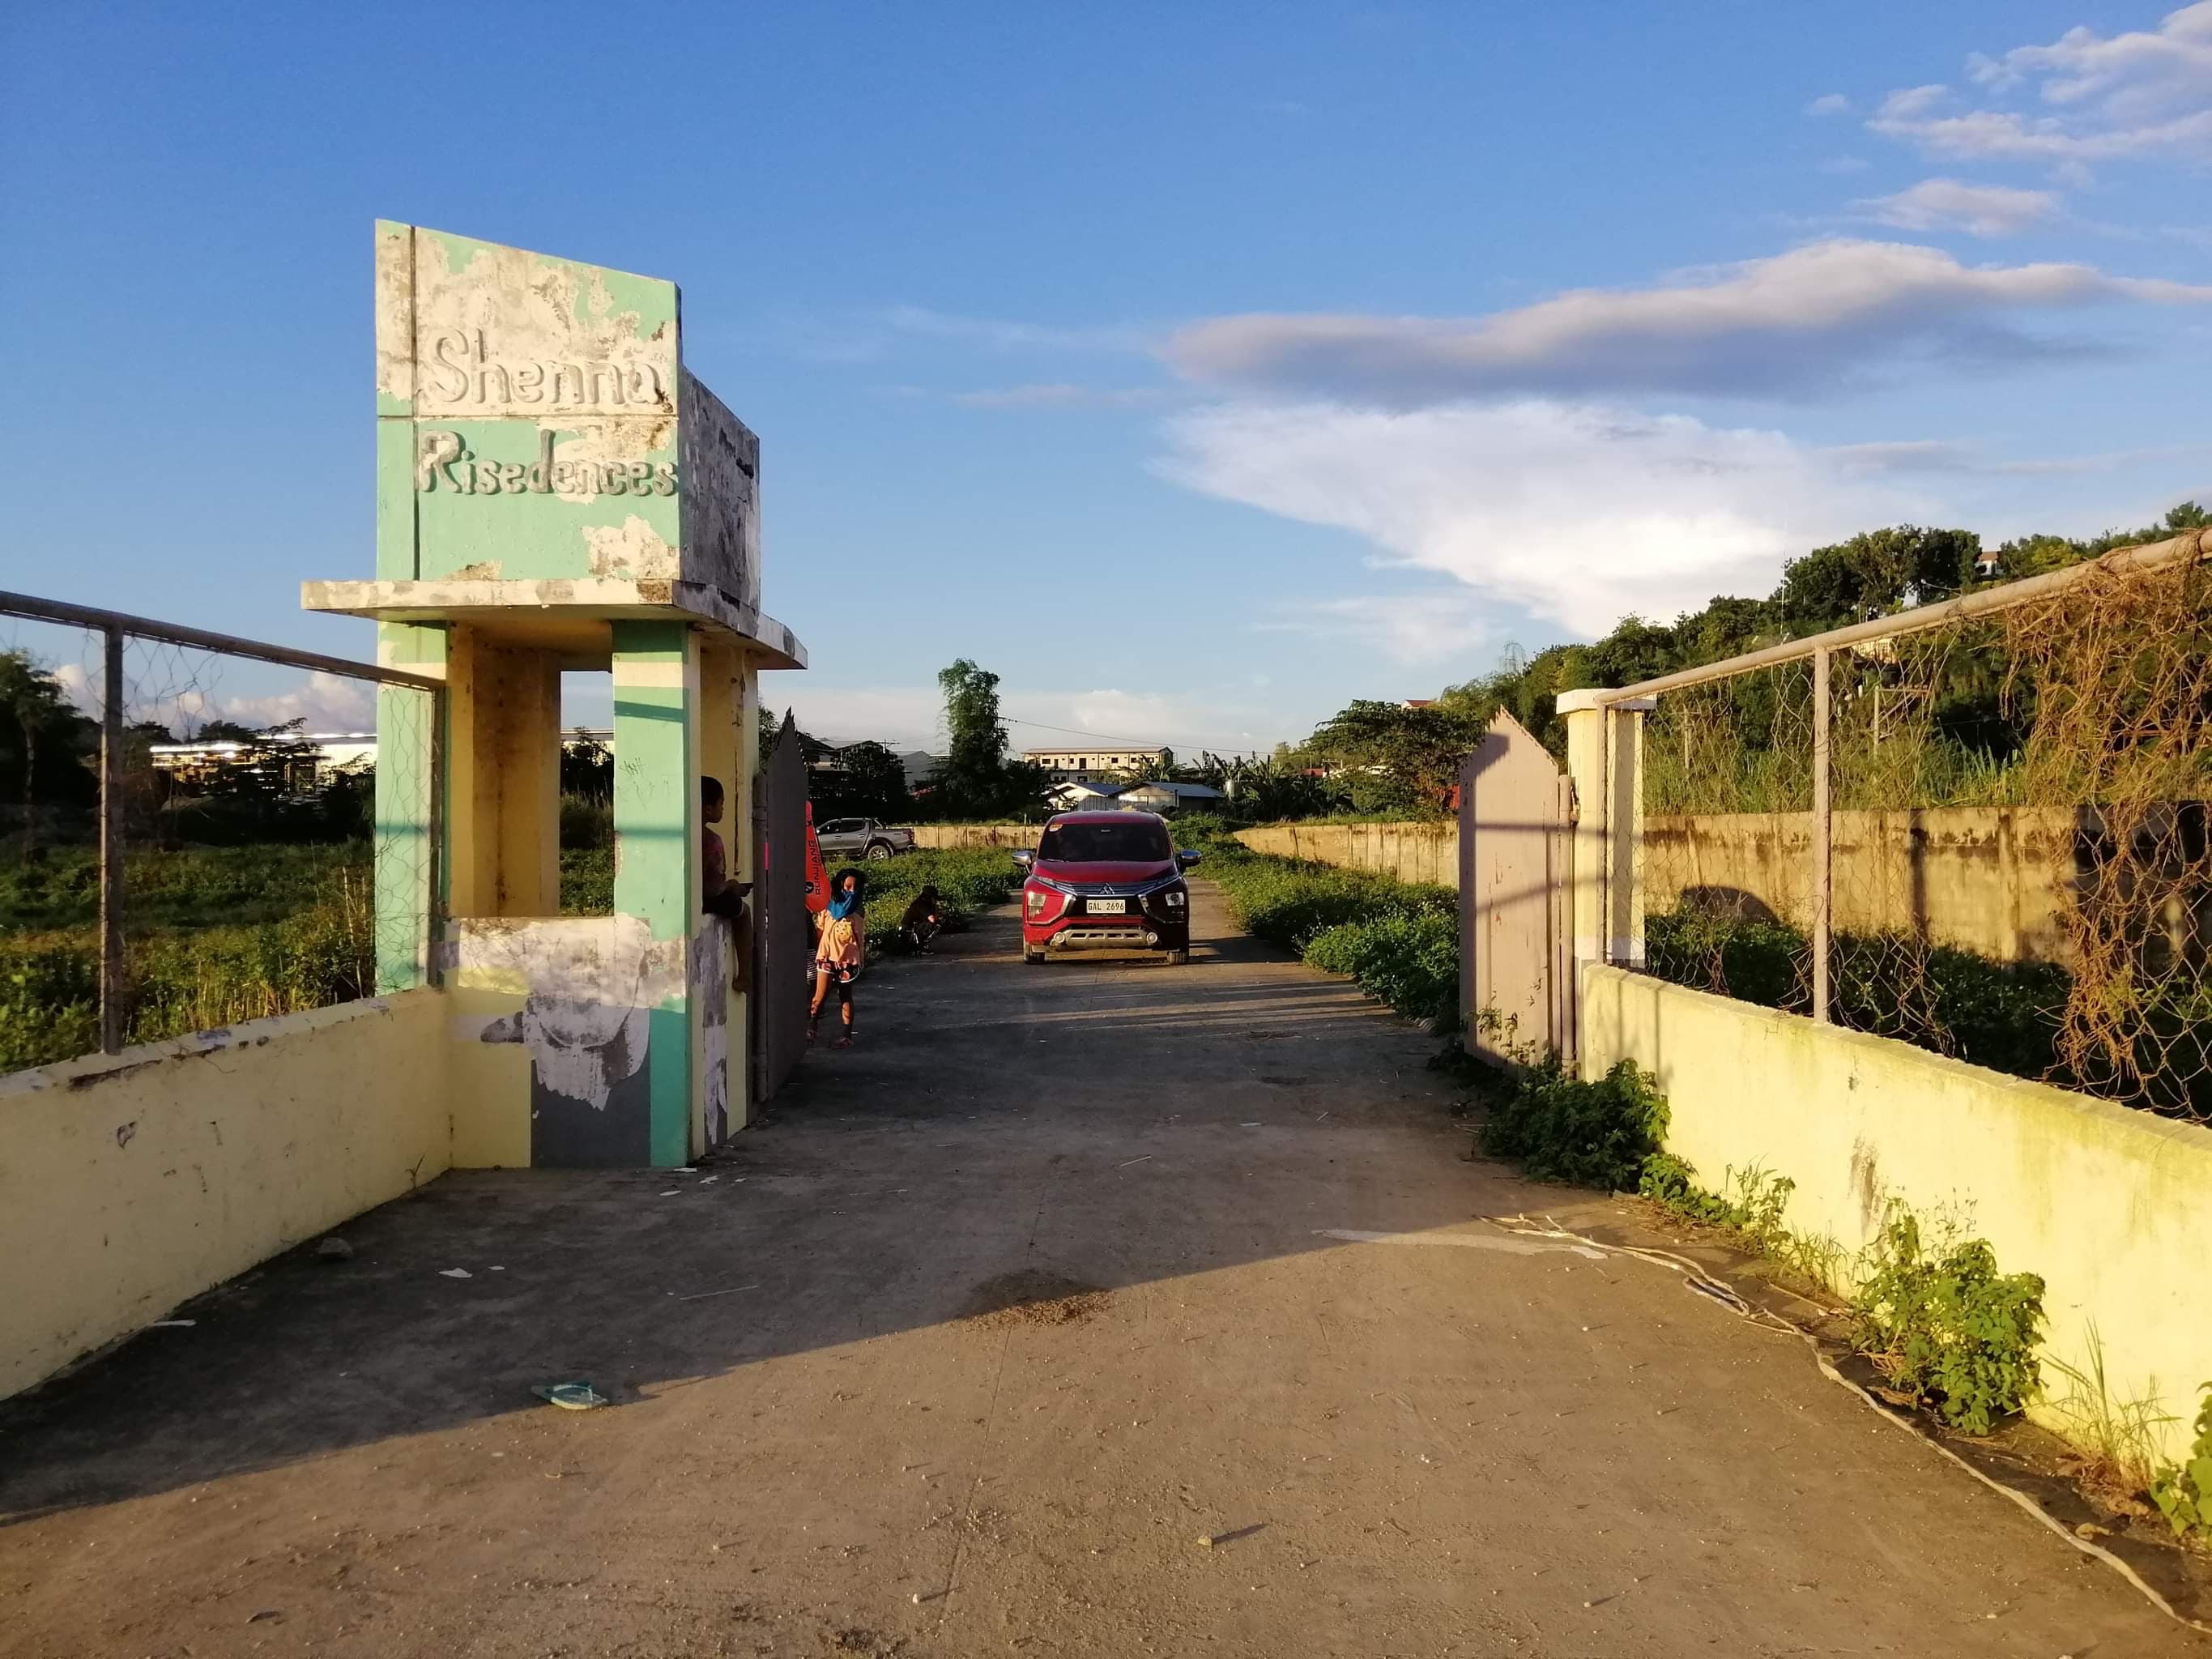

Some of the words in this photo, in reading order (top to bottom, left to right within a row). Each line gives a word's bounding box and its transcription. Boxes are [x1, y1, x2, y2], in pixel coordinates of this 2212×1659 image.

[424, 326, 663, 405] Shenna
[419, 429, 680, 497] Risedences
[1088, 902, 1102, 911] GAL
